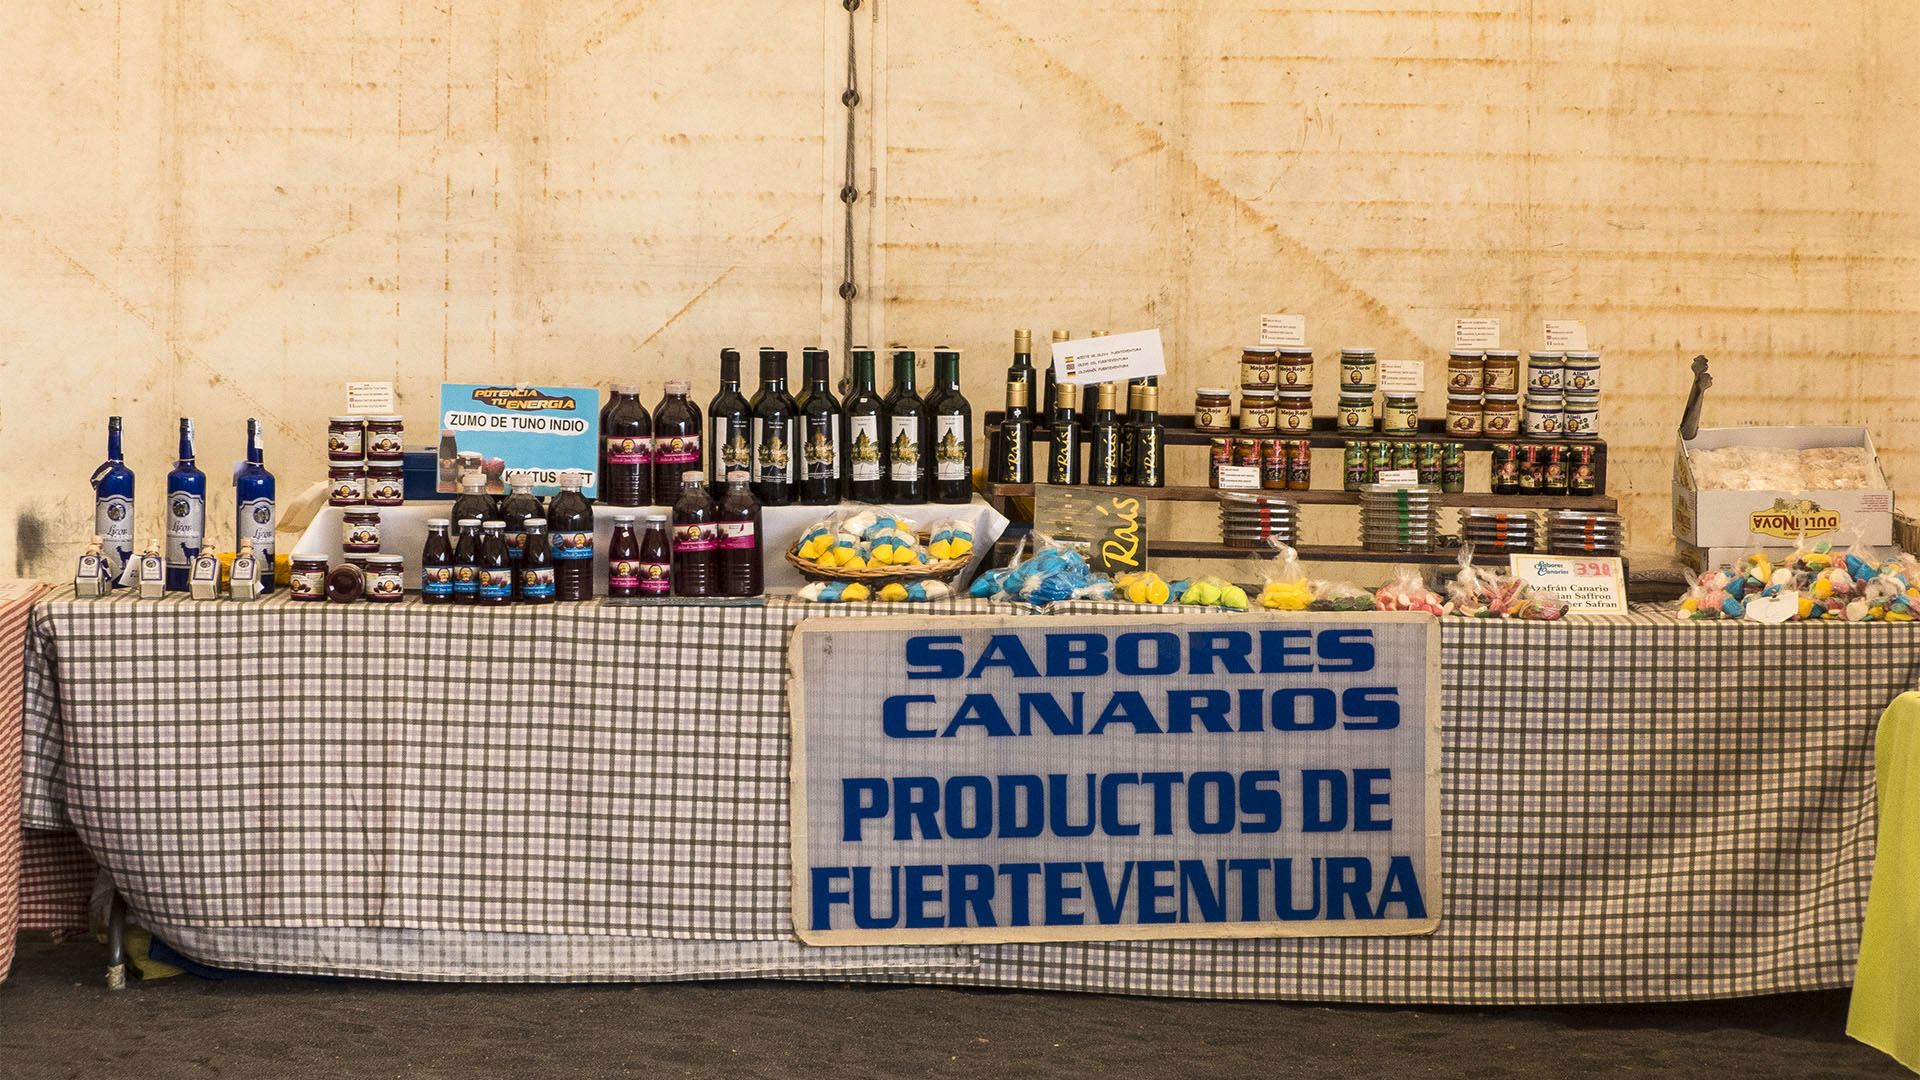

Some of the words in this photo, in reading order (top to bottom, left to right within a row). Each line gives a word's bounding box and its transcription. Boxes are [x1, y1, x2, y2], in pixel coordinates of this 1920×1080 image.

[474, 389, 538, 398] POTENCIA
[491, 398, 506, 406] TU
[506, 399, 575, 410] ENERGIA
[450, 414, 487, 427] ZUMO
[491, 416, 508, 428] DE
[511, 417, 546, 430] TUNO
[550, 419, 584, 432] INDIO
[505, 470, 557, 483] KTUS
[107, 525, 128, 537] Licor
[171, 521, 193, 533] Licor
[1095, 497, 1140, 568] Raís
[1570, 584, 1609, 592] Canario
[1575, 592, 1611, 600] Saffron
[1585, 600, 1617, 608] Safran
[905, 629, 1377, 680] SABORES
[882, 686, 1401, 738] CANARIOS
[842, 770, 1283, 842] PRODUCTOS
[1301, 768, 1393, 833] DE
[810, 856, 1429, 931] FUERTEVENTURA
